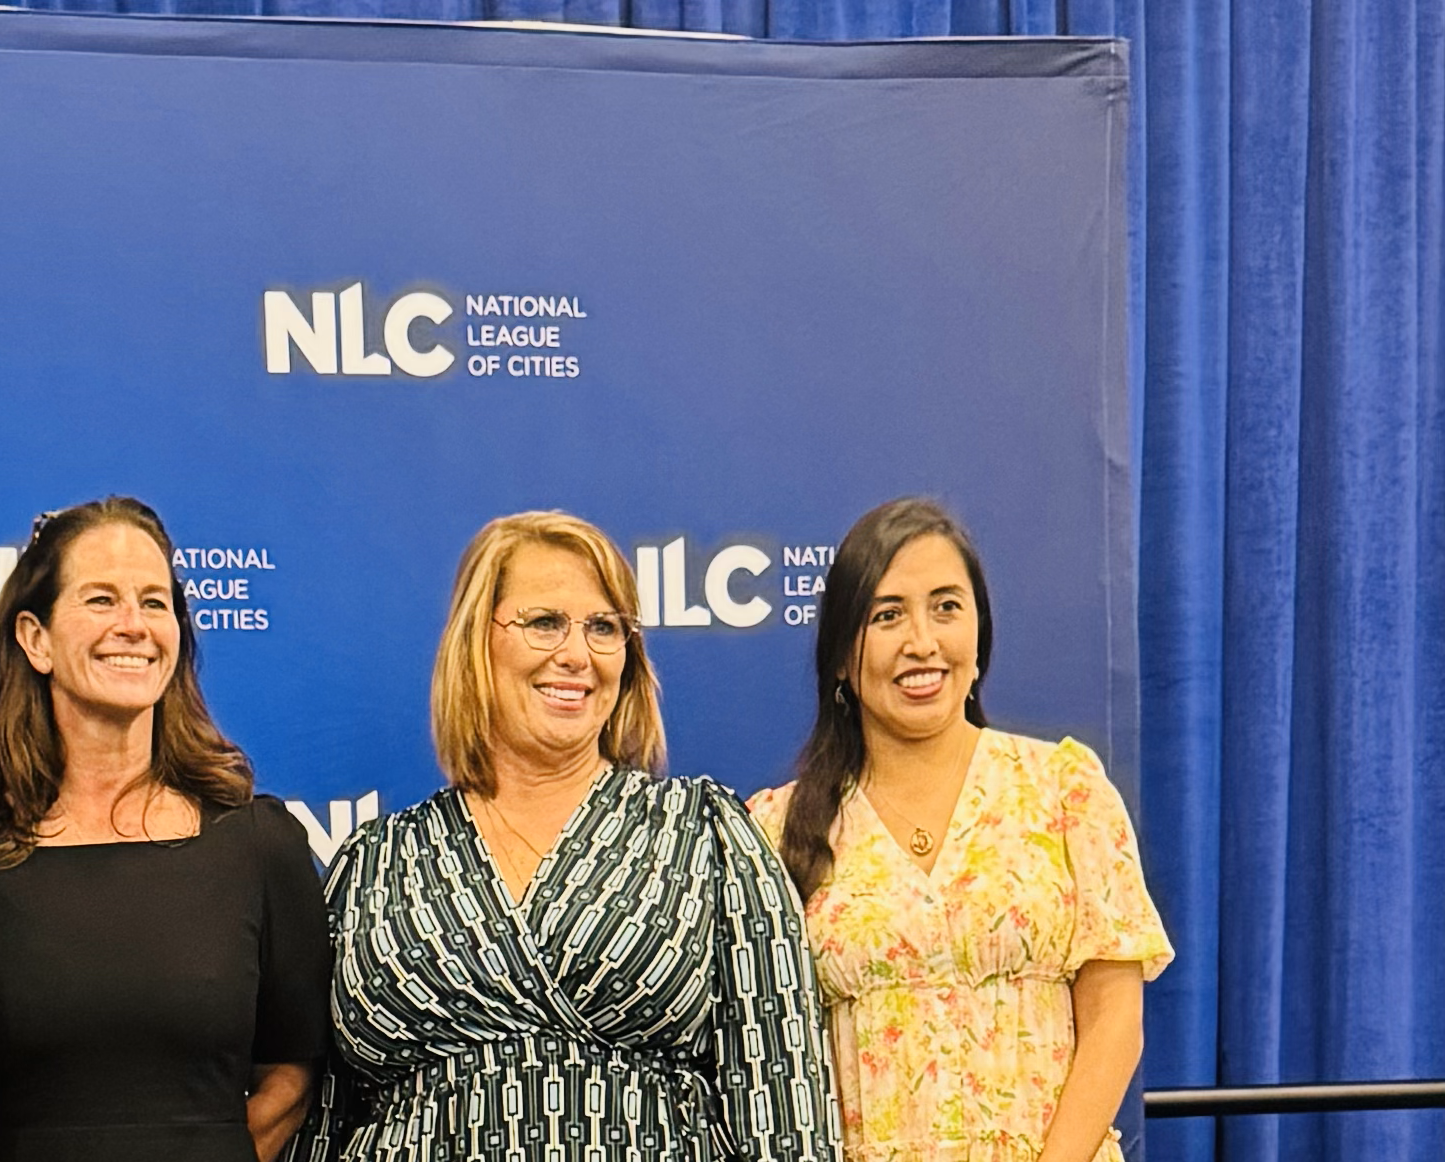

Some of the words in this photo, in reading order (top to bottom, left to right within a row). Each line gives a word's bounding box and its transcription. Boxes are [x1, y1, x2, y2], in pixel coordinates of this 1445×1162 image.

[466, 294, 587, 318] NATIONAL
[264, 281, 455, 377] NLC
[467, 325, 561, 348] LEAGUE
[467, 355, 501, 377] OF
[507, 355, 580, 378] CITIES
[172, 548, 276, 570] ATIONAL
[783, 546, 835, 567] NATI
[183, 578, 249, 600] AGUE
[784, 576, 826, 597] LEA
[194, 609, 269, 631] CITIES
[784, 605, 817, 626] OF
